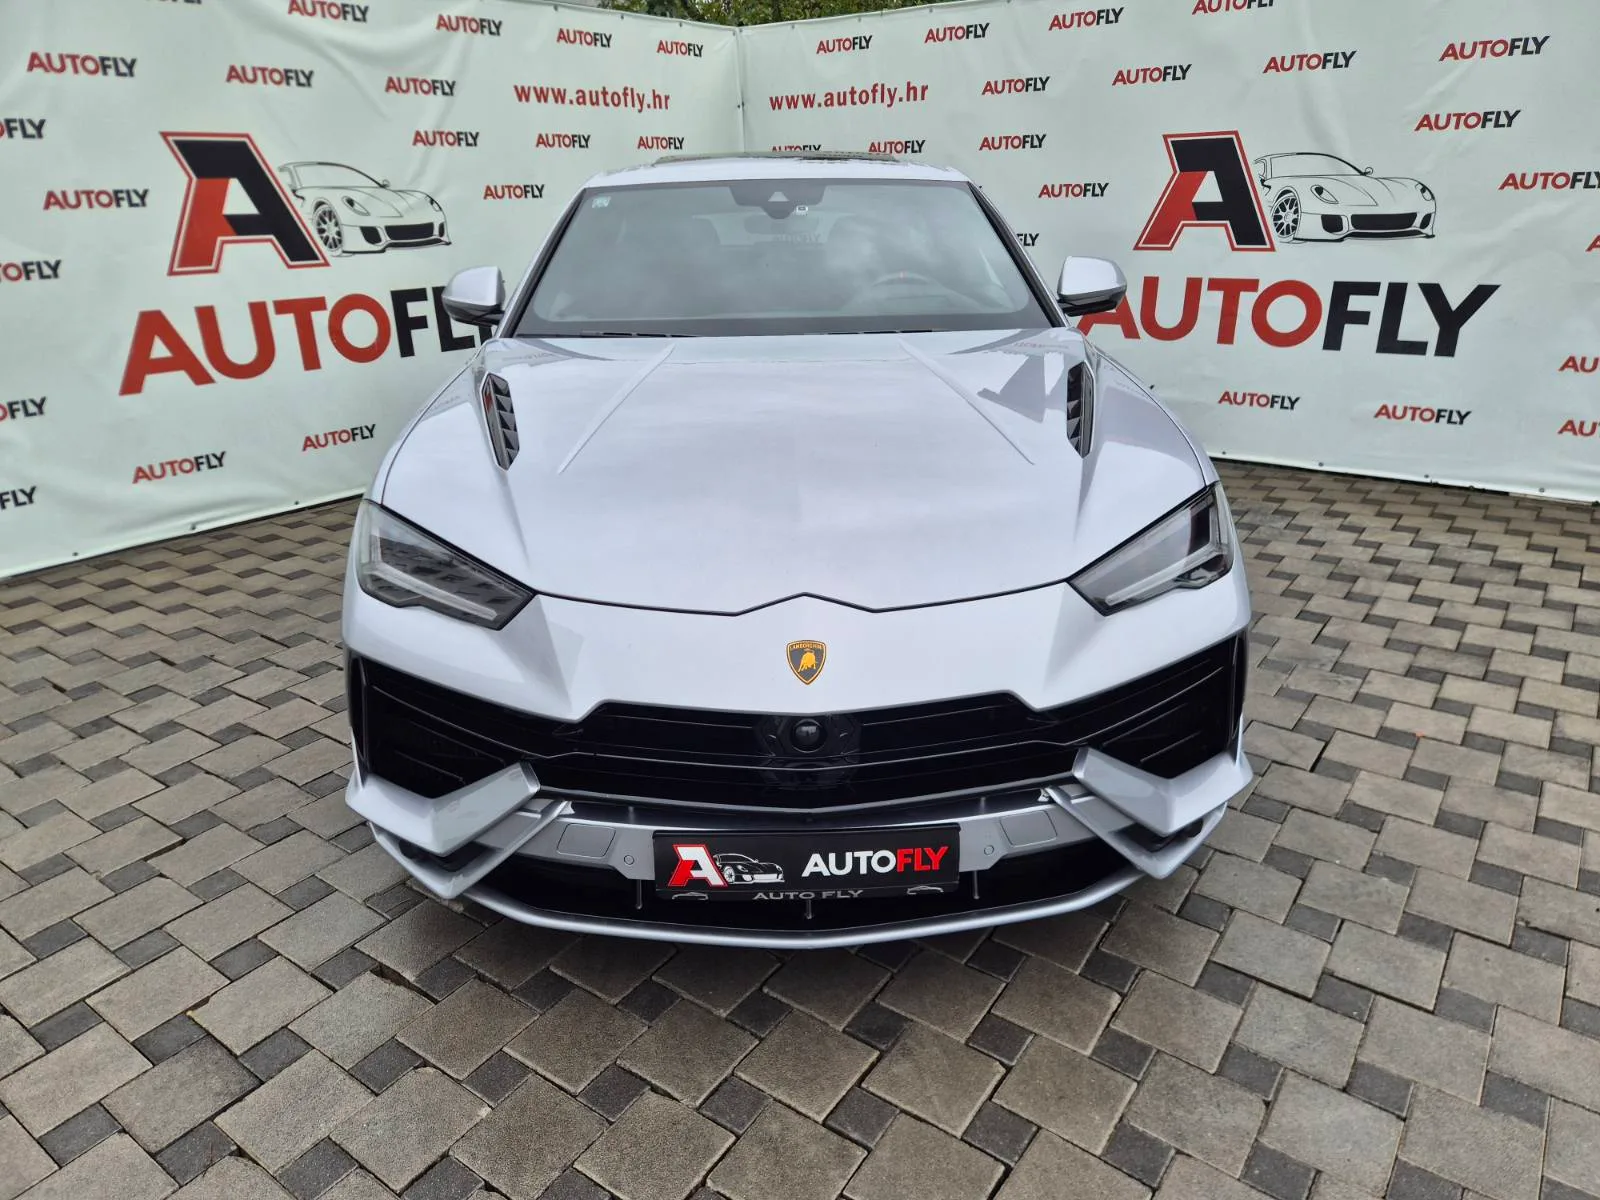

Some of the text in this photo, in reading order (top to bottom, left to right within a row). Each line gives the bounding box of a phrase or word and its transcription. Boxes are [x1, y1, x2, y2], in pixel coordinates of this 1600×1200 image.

[288, 0, 369, 23] AUTOFLY
[1049, 7, 1124, 31] AUTOFLY
[436, 15, 502, 36] AUTOFLY
[925, 23, 990, 43] AUTOFLY
[557, 28, 612, 48] AUTOFLY
[657, 40, 703, 57] AUTOFLY
[817, 35, 872, 54] AUTOFLY
[1439, 36, 1550, 61] AUTOFLY
[27, 52, 136, 77] AUTOFLY
[1263, 51, 1357, 73] AUTOFLY
[226, 65, 314, 87] AUTOFLY
[1112, 64, 1192, 85] AUTOFLY
[385, 77, 456, 96] AUTOFLY
[769, 81, 928, 110] www.autofly.hr
[982, 76, 1050, 95] AUTOFLY
[514, 85, 670, 113] www.autofly.hr
[0, 118, 46, 139] FLY
[1415, 110, 1521, 131] AUTOFLY
[413, 131, 479, 147] AUTOFLY
[536, 134, 591, 148] AUTOFLY
[638, 136, 684, 150] AUTOFLY
[868, 140, 925, 154] AUTOFLY
[979, 134, 1046, 150] AUTOFLY
[43, 189, 149, 210] AUTOFLY
[484, 184, 544, 199] AUTOFLY
[1038, 183, 1109, 198] AUTOFLY
[0, 260, 61, 281] OFLY
[1074, 276, 1501, 357] AUTOFLY
[119, 288, 492, 395] AUTOFL
[1218, 391, 1300, 410] AUTOFLY
[1374, 405, 1471, 425] AUTOFLY
[303, 424, 376, 451] AUTOFLY
[1558, 420, 1600, 436] AU
[133, 451, 226, 483] AUTOFLY
[802, 847, 948, 877] AUTOFLY
[822, 890, 863, 898] FLY
